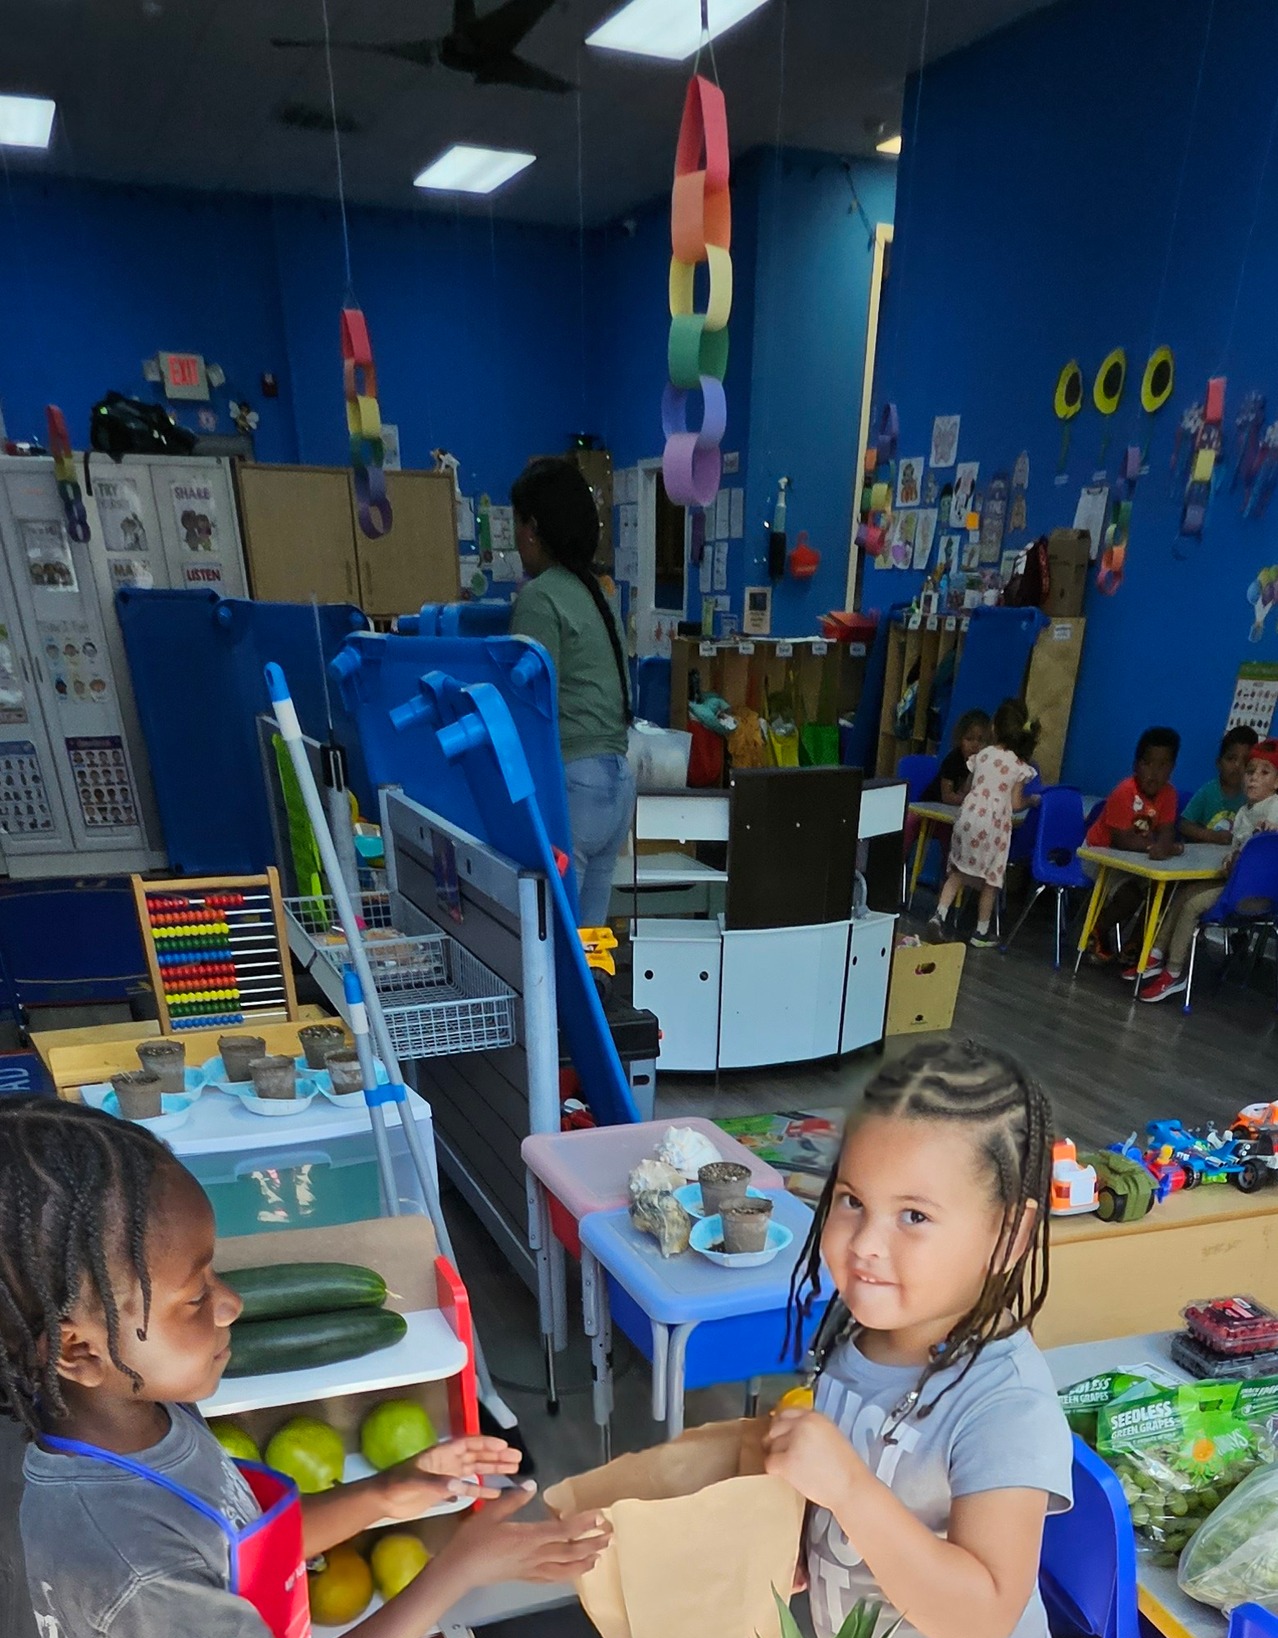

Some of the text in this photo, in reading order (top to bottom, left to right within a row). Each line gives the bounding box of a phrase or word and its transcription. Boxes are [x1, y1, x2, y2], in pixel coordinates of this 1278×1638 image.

[168, 355, 199, 386] EXIT
[186, 568, 221, 582] LISTEN
[1080, 1391, 1110, 1404] GRAPES
[1110, 1400, 1174, 1432] SEEDLESS
[1111, 1424, 1140, 1441] GREEN
[1140, 1416, 1176, 1434] GRAPES
